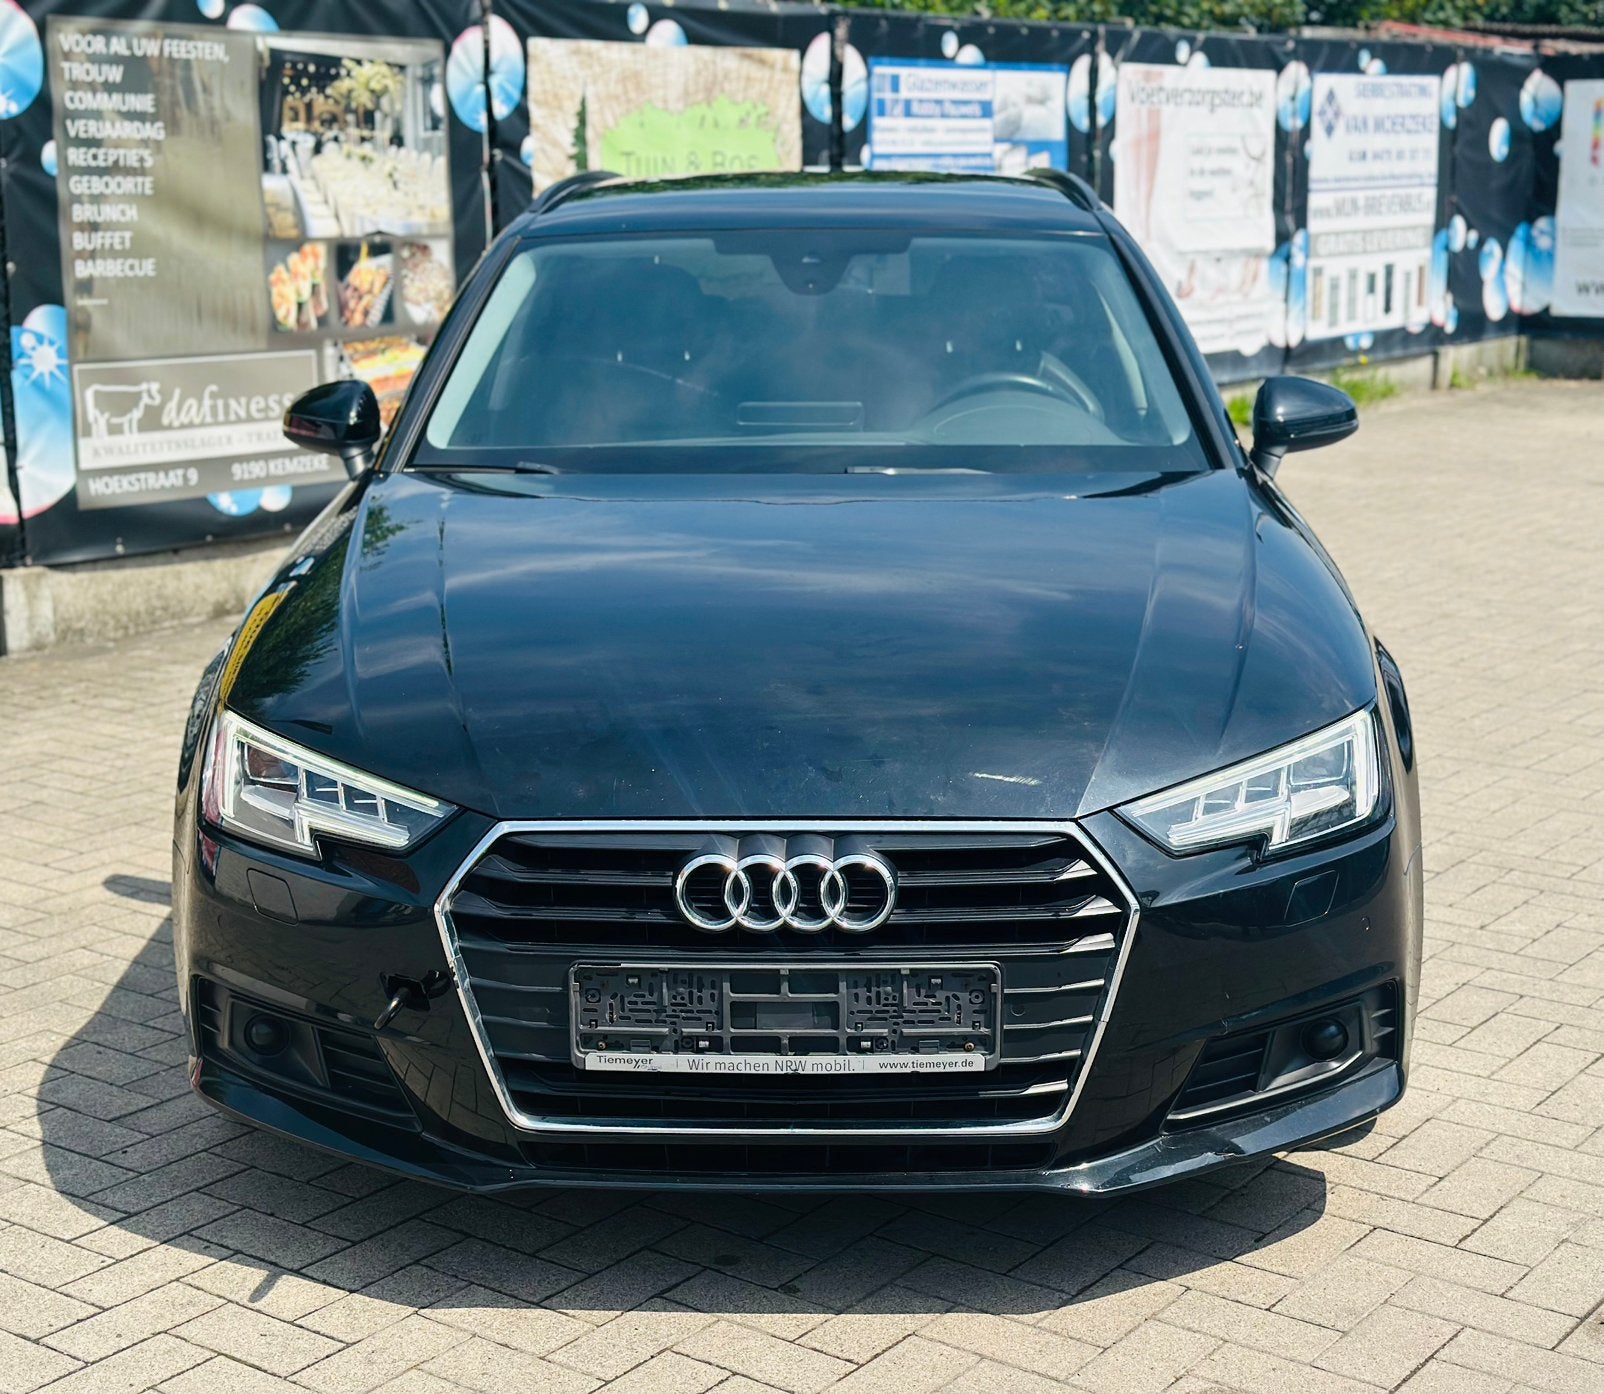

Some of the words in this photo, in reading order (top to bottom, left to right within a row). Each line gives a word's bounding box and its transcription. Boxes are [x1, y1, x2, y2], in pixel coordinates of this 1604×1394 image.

[60, 34, 106, 54] VOOR
[109, 36, 131, 56] AL
[132, 38, 161, 57] UW
[163, 39, 229, 63] FEESTEN,
[61, 62, 124, 83] TROUW
[64, 91, 156, 112] COMMUNIE
[66, 120, 165, 140] VERJAARDAG
[67, 147, 153, 167] RECEPTIE'S
[69, 175, 154, 195] GEBOORTE
[72, 203, 138, 223] BRUNCH
[72, 231, 133, 251] BUFFET
[75, 259, 156, 278] BARBECUE
[88, 468, 184, 496] HOEKSTRAAT
[186, 467, 199, 486] 9
[231, 459, 267, 481] 9190
[596, 1055, 653, 1070] Tiemeyer
[687, 1058, 710, 1071] Wir
[714, 1059, 769, 1072] machen
[774, 1060, 807, 1072] NRW
[811, 1059, 855, 1072] mobil.
[879, 1059, 974, 1070] www.tiemeyer.de
